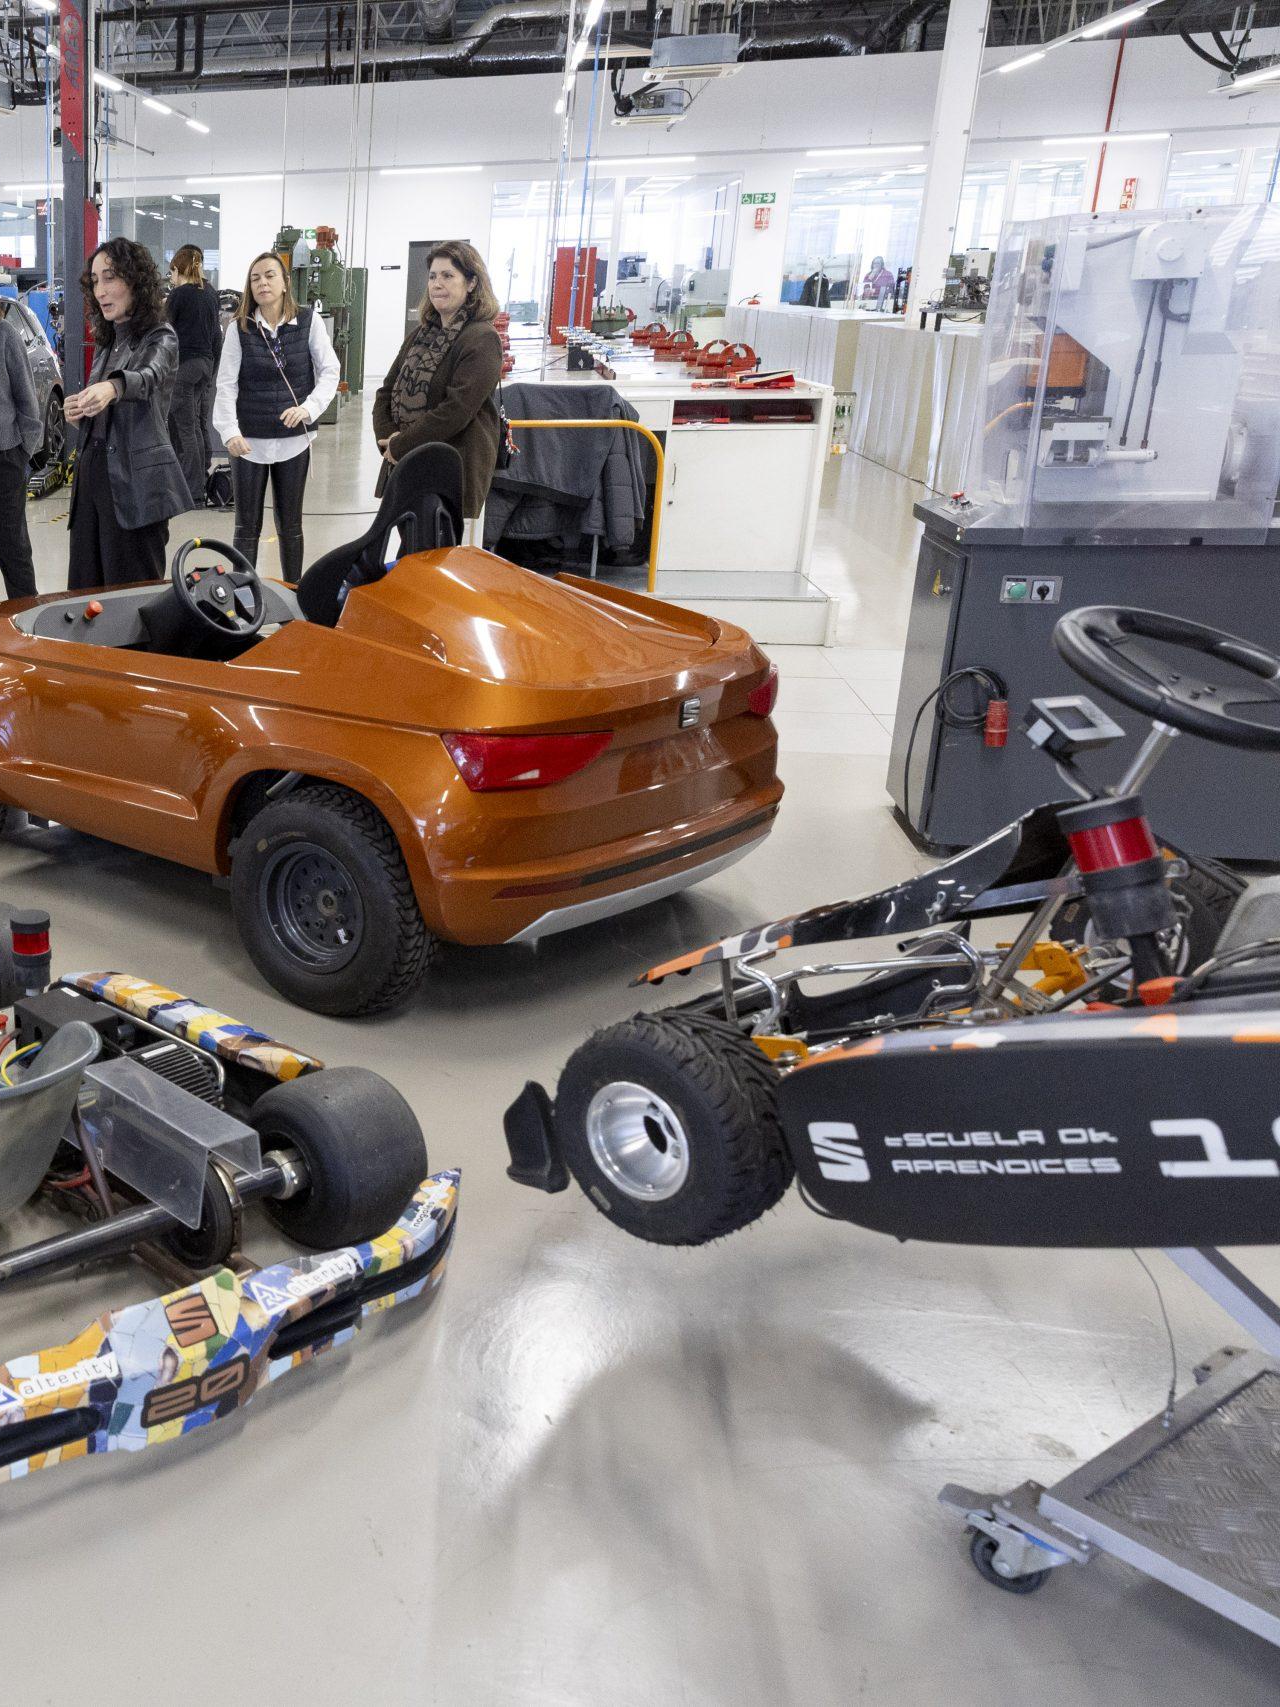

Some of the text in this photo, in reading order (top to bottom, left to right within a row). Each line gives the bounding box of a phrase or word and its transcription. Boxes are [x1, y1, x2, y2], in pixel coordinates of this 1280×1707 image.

[1149, 1116, 1280, 1178] 1
[891, 1157, 1122, 1176] APRENDICES
[291, 1259, 353, 1294] alterity
[23, 1359, 113, 1396] alterity
[141, 1352, 251, 1429] 20
